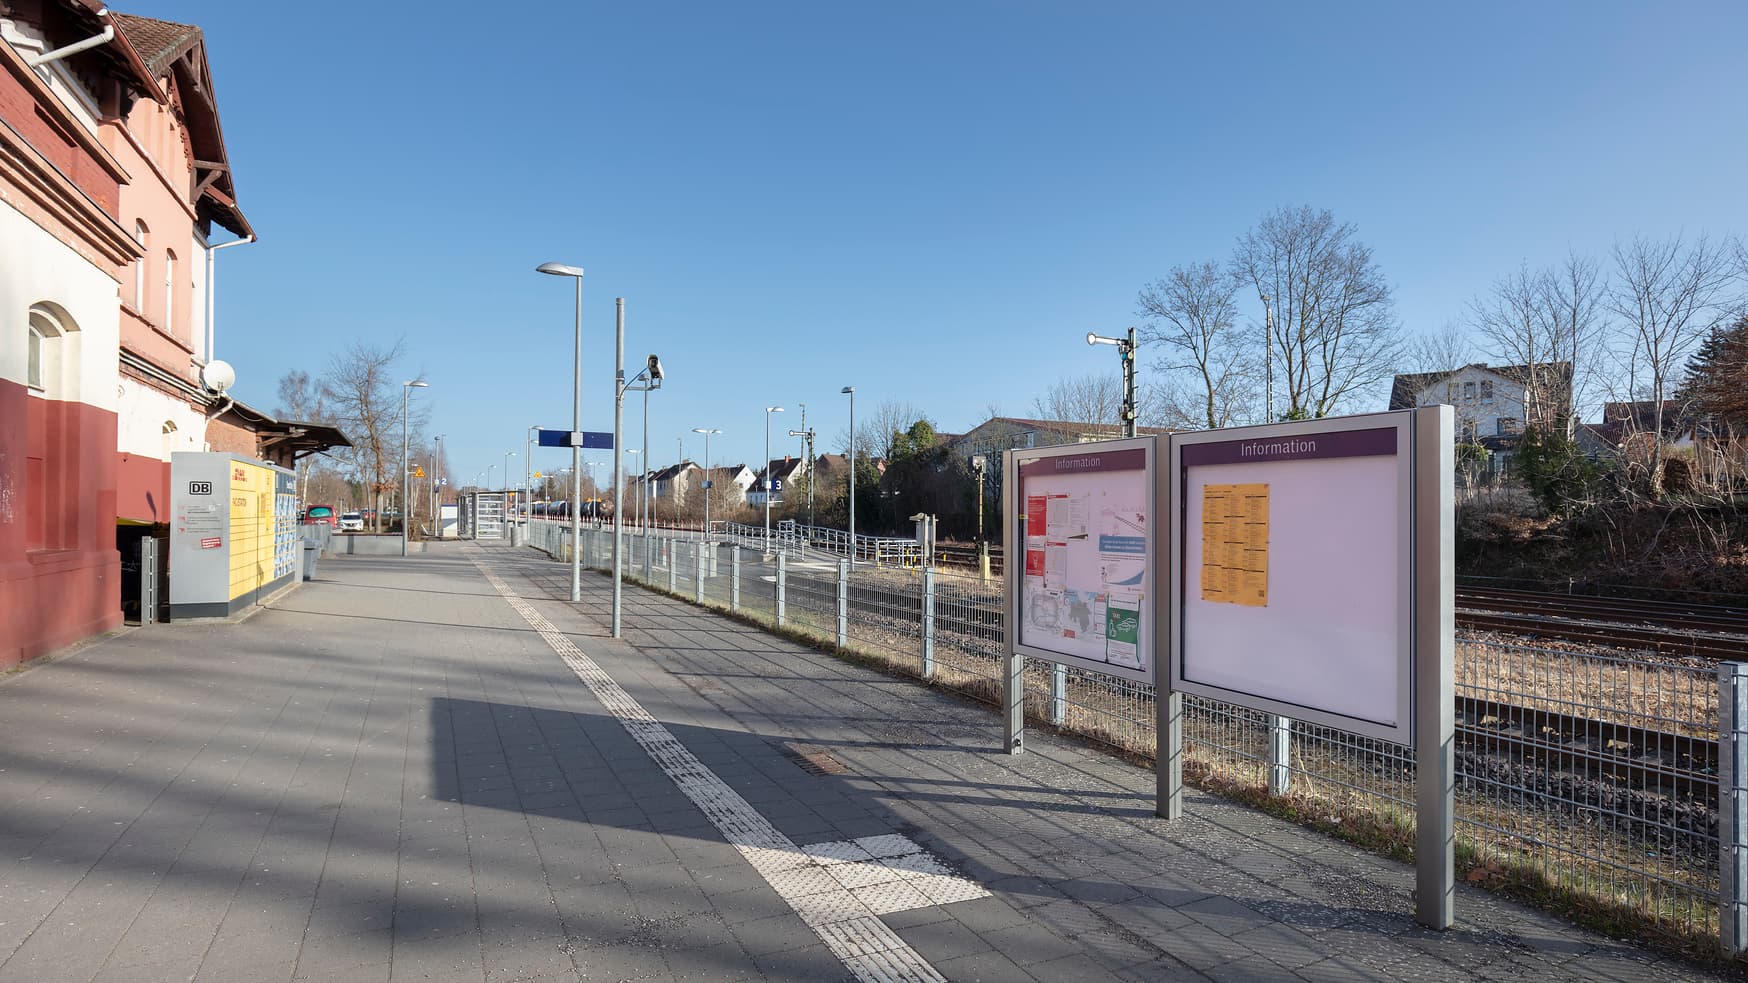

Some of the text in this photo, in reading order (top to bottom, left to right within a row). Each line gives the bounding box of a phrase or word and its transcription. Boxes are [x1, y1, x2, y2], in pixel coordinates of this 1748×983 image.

[1240, 440, 1317, 457] Information
[1055, 457, 1101, 470] Information
[440, 477, 448, 485] 2
[775, 480, 782, 490] 3
[191, 483, 210, 493] DB
